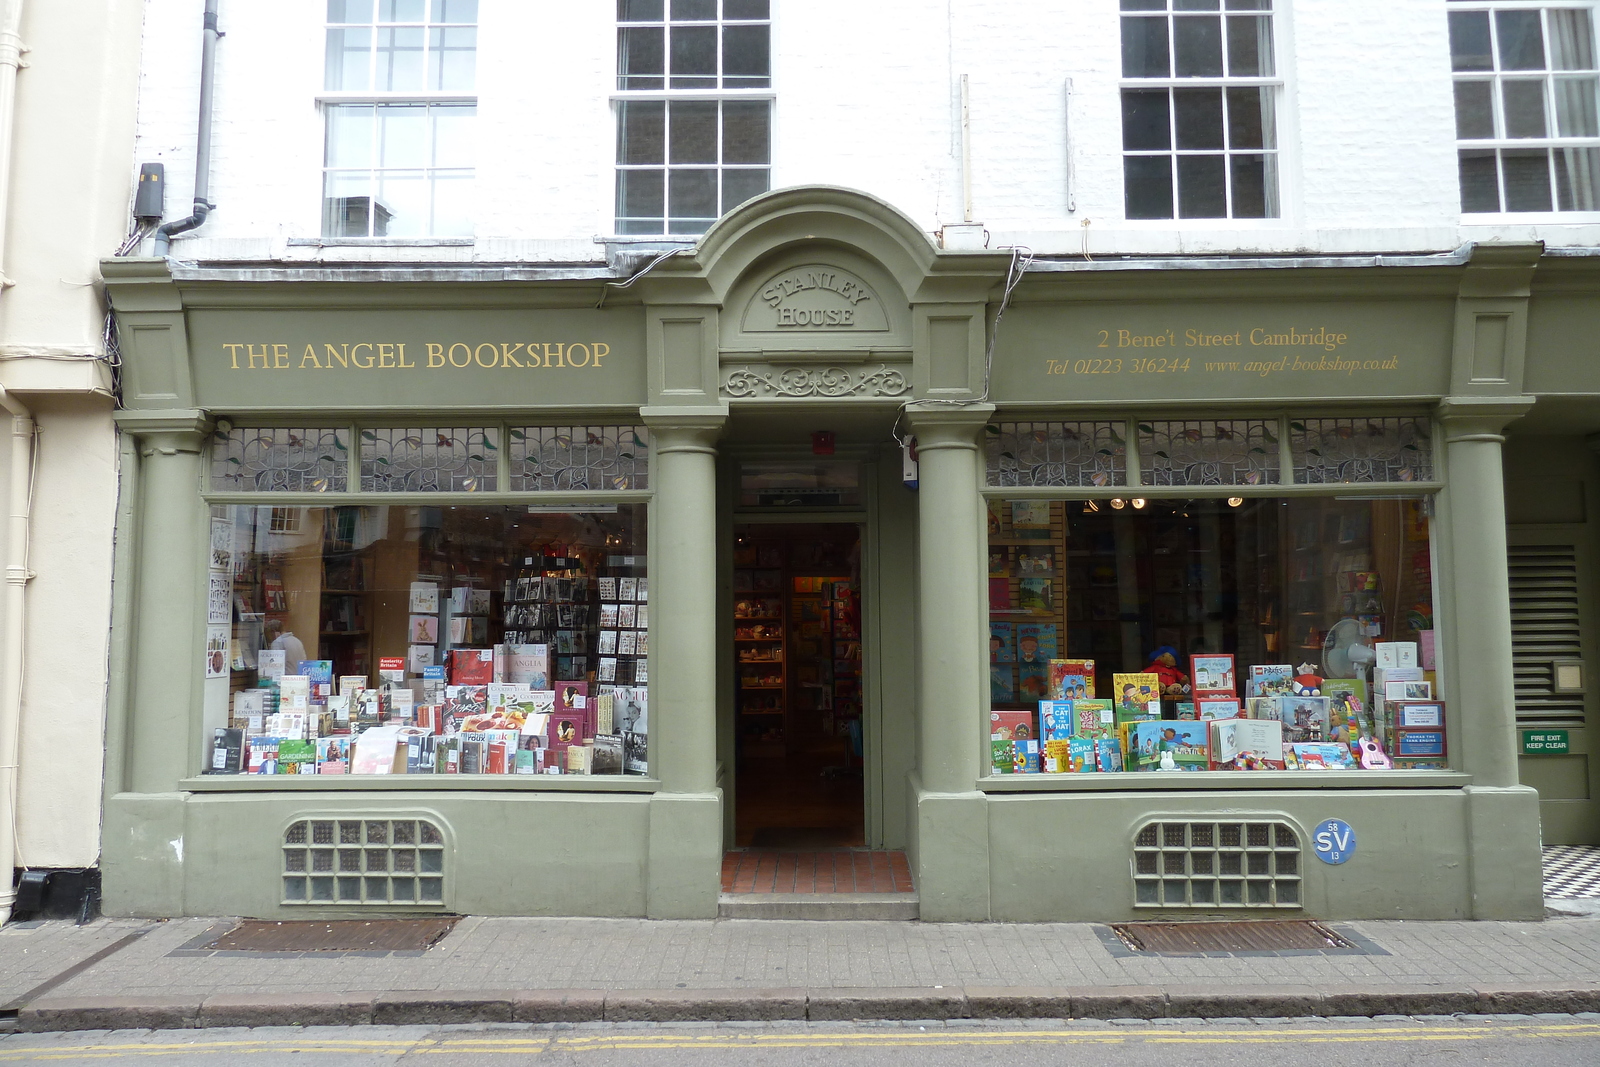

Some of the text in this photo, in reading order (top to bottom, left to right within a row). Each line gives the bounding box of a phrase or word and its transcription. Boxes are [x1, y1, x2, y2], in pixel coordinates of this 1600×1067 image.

[762, 272, 870, 308] STANLEY
[777, 308, 854, 326] HOUSE
[1097, 327, 1347, 351] 2 Bene't Street Cambridge
[223, 342, 610, 369] THE ANGEL BOOKSHOP
[1046, 359, 1068, 375] Tel
[1074, 359, 1122, 375] 01223
[1129, 357, 1190, 374] 316244
[1071, 745, 1092, 753] LORAX
[1328, 823, 1338, 832] 58
[1316, 831, 1350, 852] SV
[1331, 852, 1339, 860] 13
